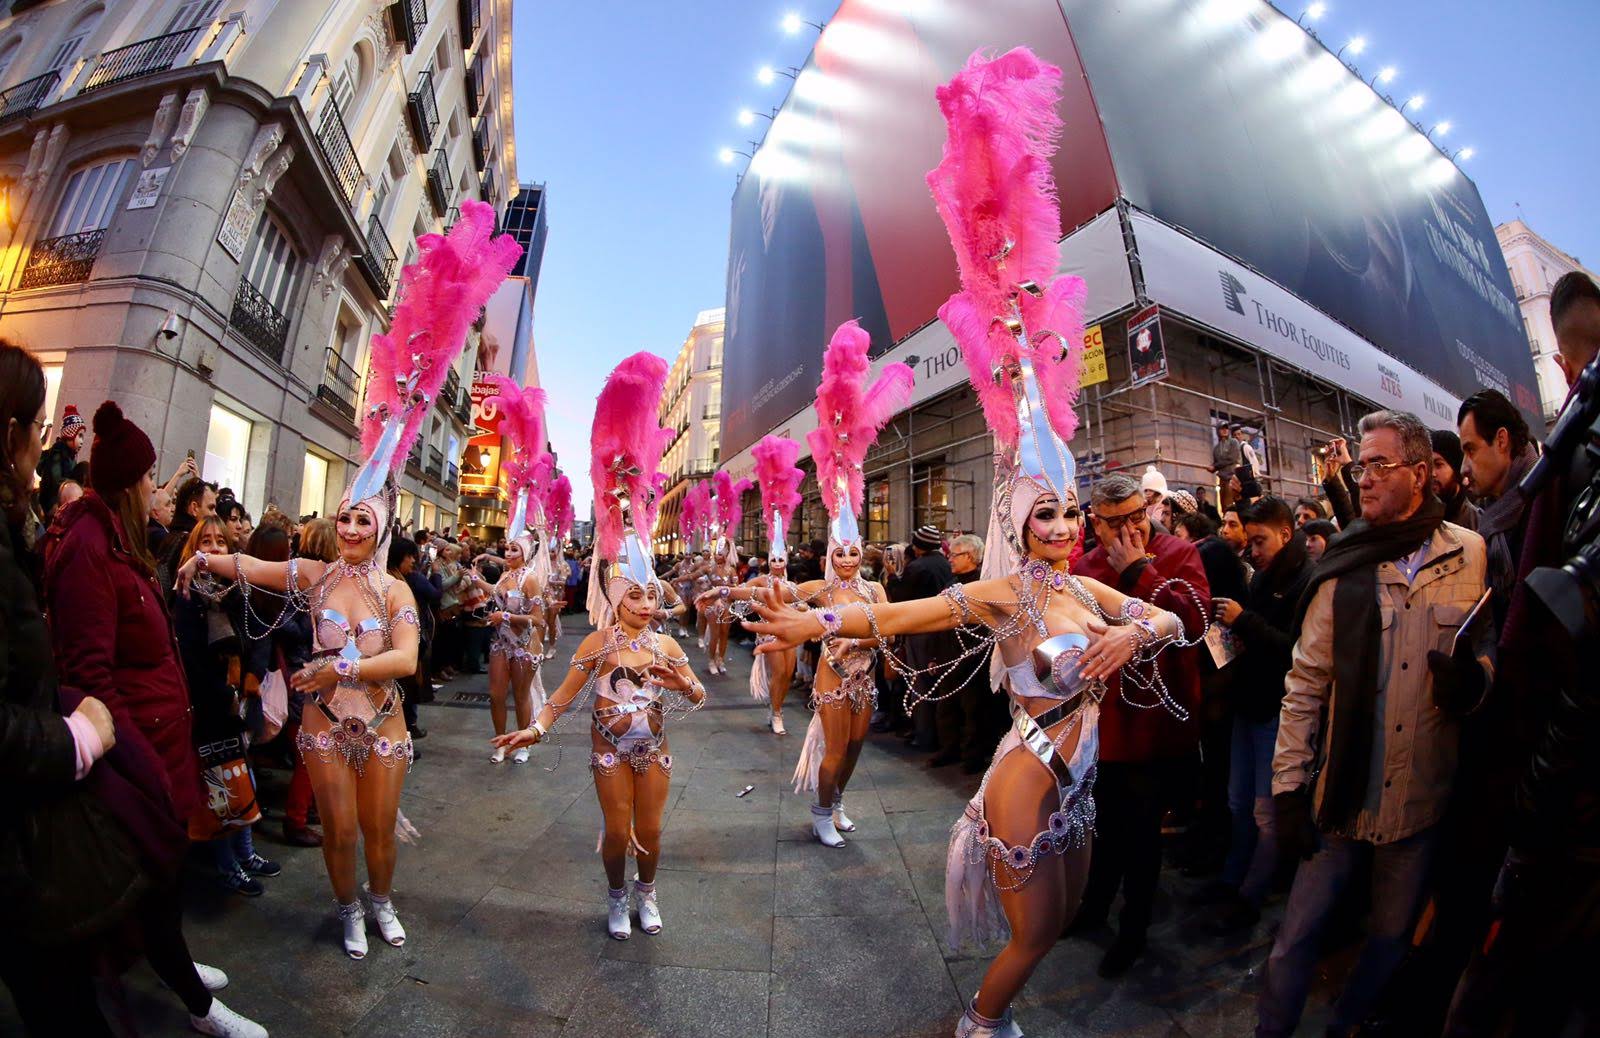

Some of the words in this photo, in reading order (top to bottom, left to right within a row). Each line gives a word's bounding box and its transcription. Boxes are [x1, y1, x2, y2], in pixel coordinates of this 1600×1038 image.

[1251, 299, 1301, 345] THOR
[1300, 327, 1351, 371] EQUITIES
[923, 346, 964, 379] THO
[471, 384, 500, 396] ebajas
[1380, 374, 1403, 399] ATES
